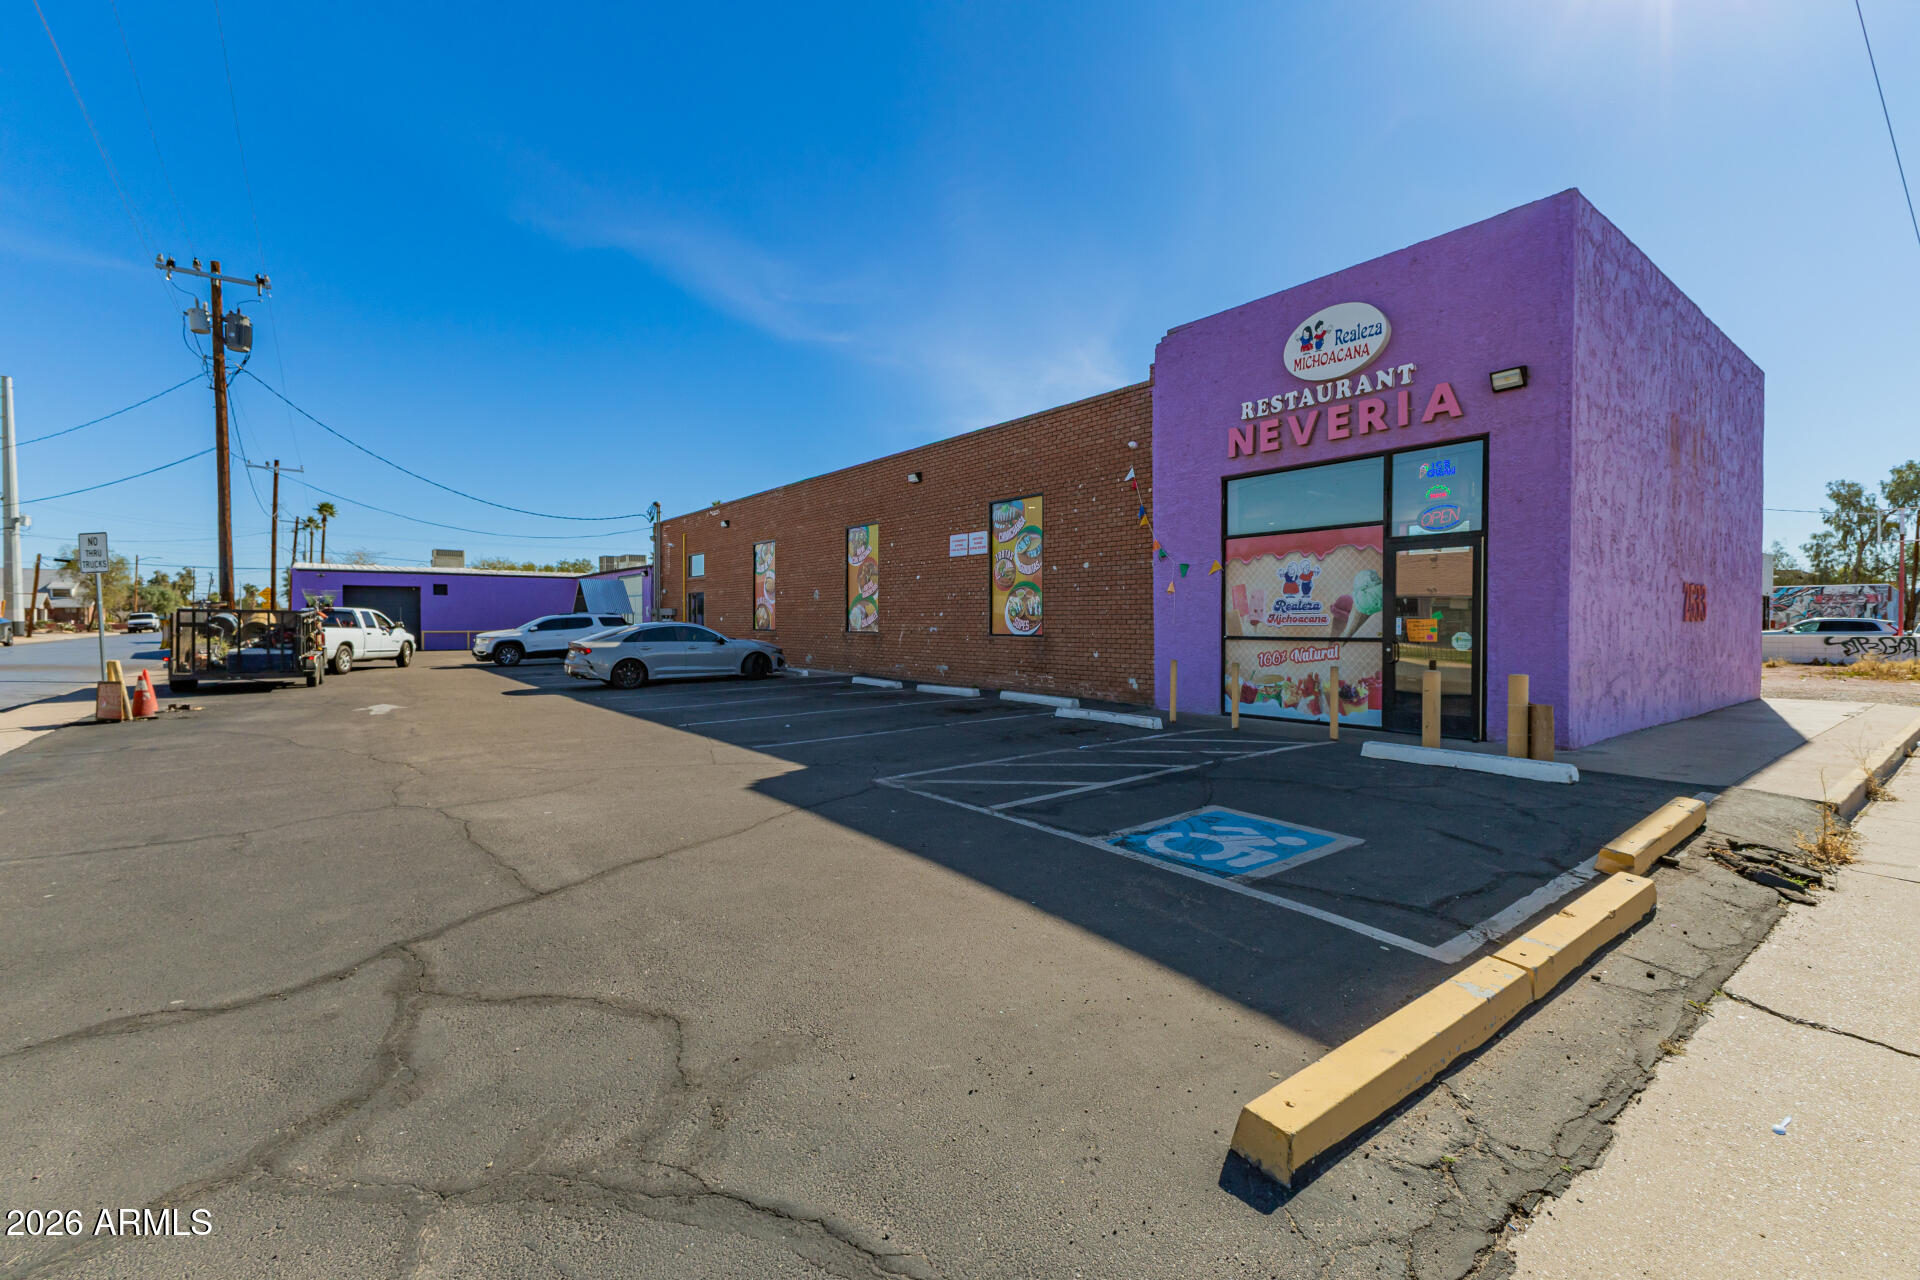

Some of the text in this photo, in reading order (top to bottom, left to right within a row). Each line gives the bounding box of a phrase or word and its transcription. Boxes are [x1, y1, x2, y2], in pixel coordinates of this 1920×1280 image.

[1335, 322, 1382, 346] Realeza
[1293, 343, 1370, 372] MICHOACANA
[1240, 363, 1416, 420] RESTAURANT
[1227, 382, 1464, 458] NEVERIA
[1421, 506, 1461, 527] OPEN
[87, 536, 98, 547] NO
[85, 549, 102, 558] THRU
[82, 560, 107, 569] TRUCKS
[1273, 599, 1321, 613] Realeza
[1013, 617, 1030, 631] SOPES
[1267, 614, 1328, 625] Michoacana
[1258, 644, 1340, 667] 100% Natural
